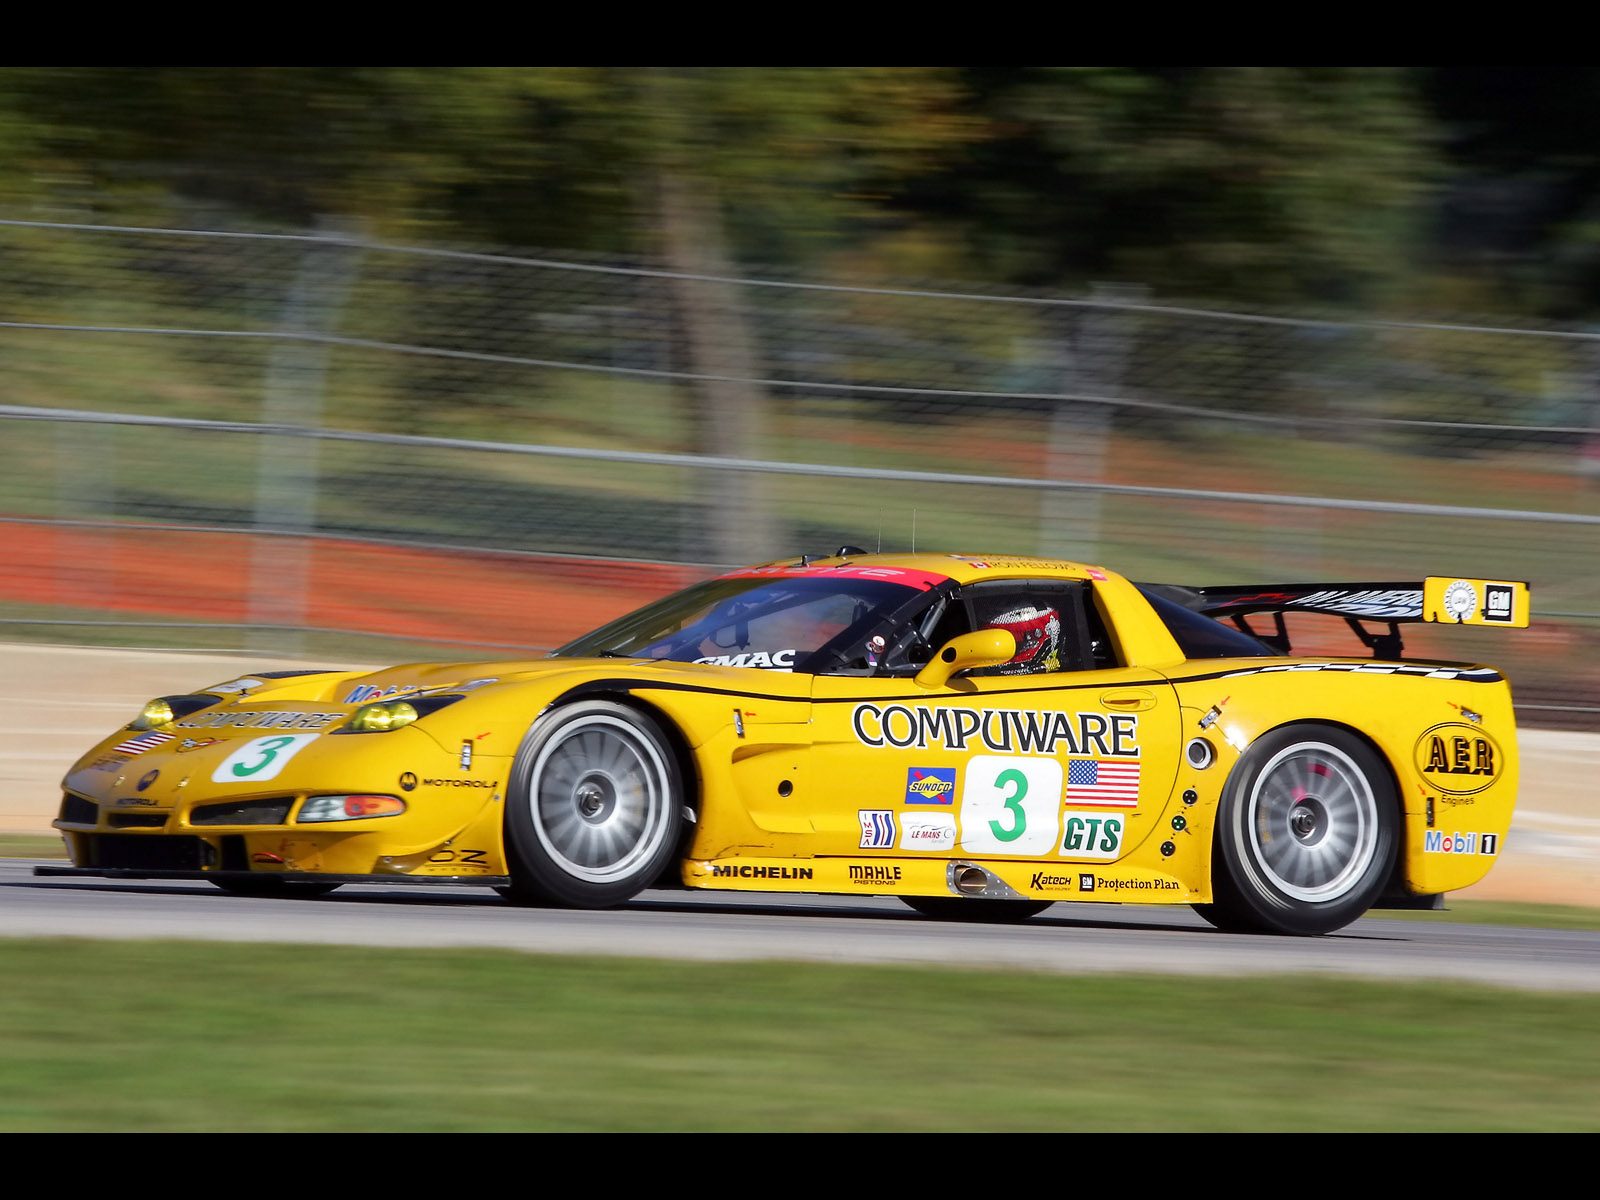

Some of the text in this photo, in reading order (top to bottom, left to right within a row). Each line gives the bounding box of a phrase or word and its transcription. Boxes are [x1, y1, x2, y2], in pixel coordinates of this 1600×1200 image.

[1487, 590, 1511, 610] GM
[853, 704, 1140, 756] COMPUWARE
[232, 736, 296, 777] 3
[1424, 735, 1494, 776] AER
[910, 782, 951, 793] SUNOCO
[988, 768, 1029, 842] 3
[1441, 795, 1475, 807] Engines
[911, 830, 941, 839] LE MANS
[1064, 817, 1121, 853] GTS
[1425, 831, 1494, 853] Mobil 1
[713, 865, 813, 880] MICHELIN
[849, 865, 902, 880] MAHLE
[1082, 876, 1180, 890] GM Protection Plan
